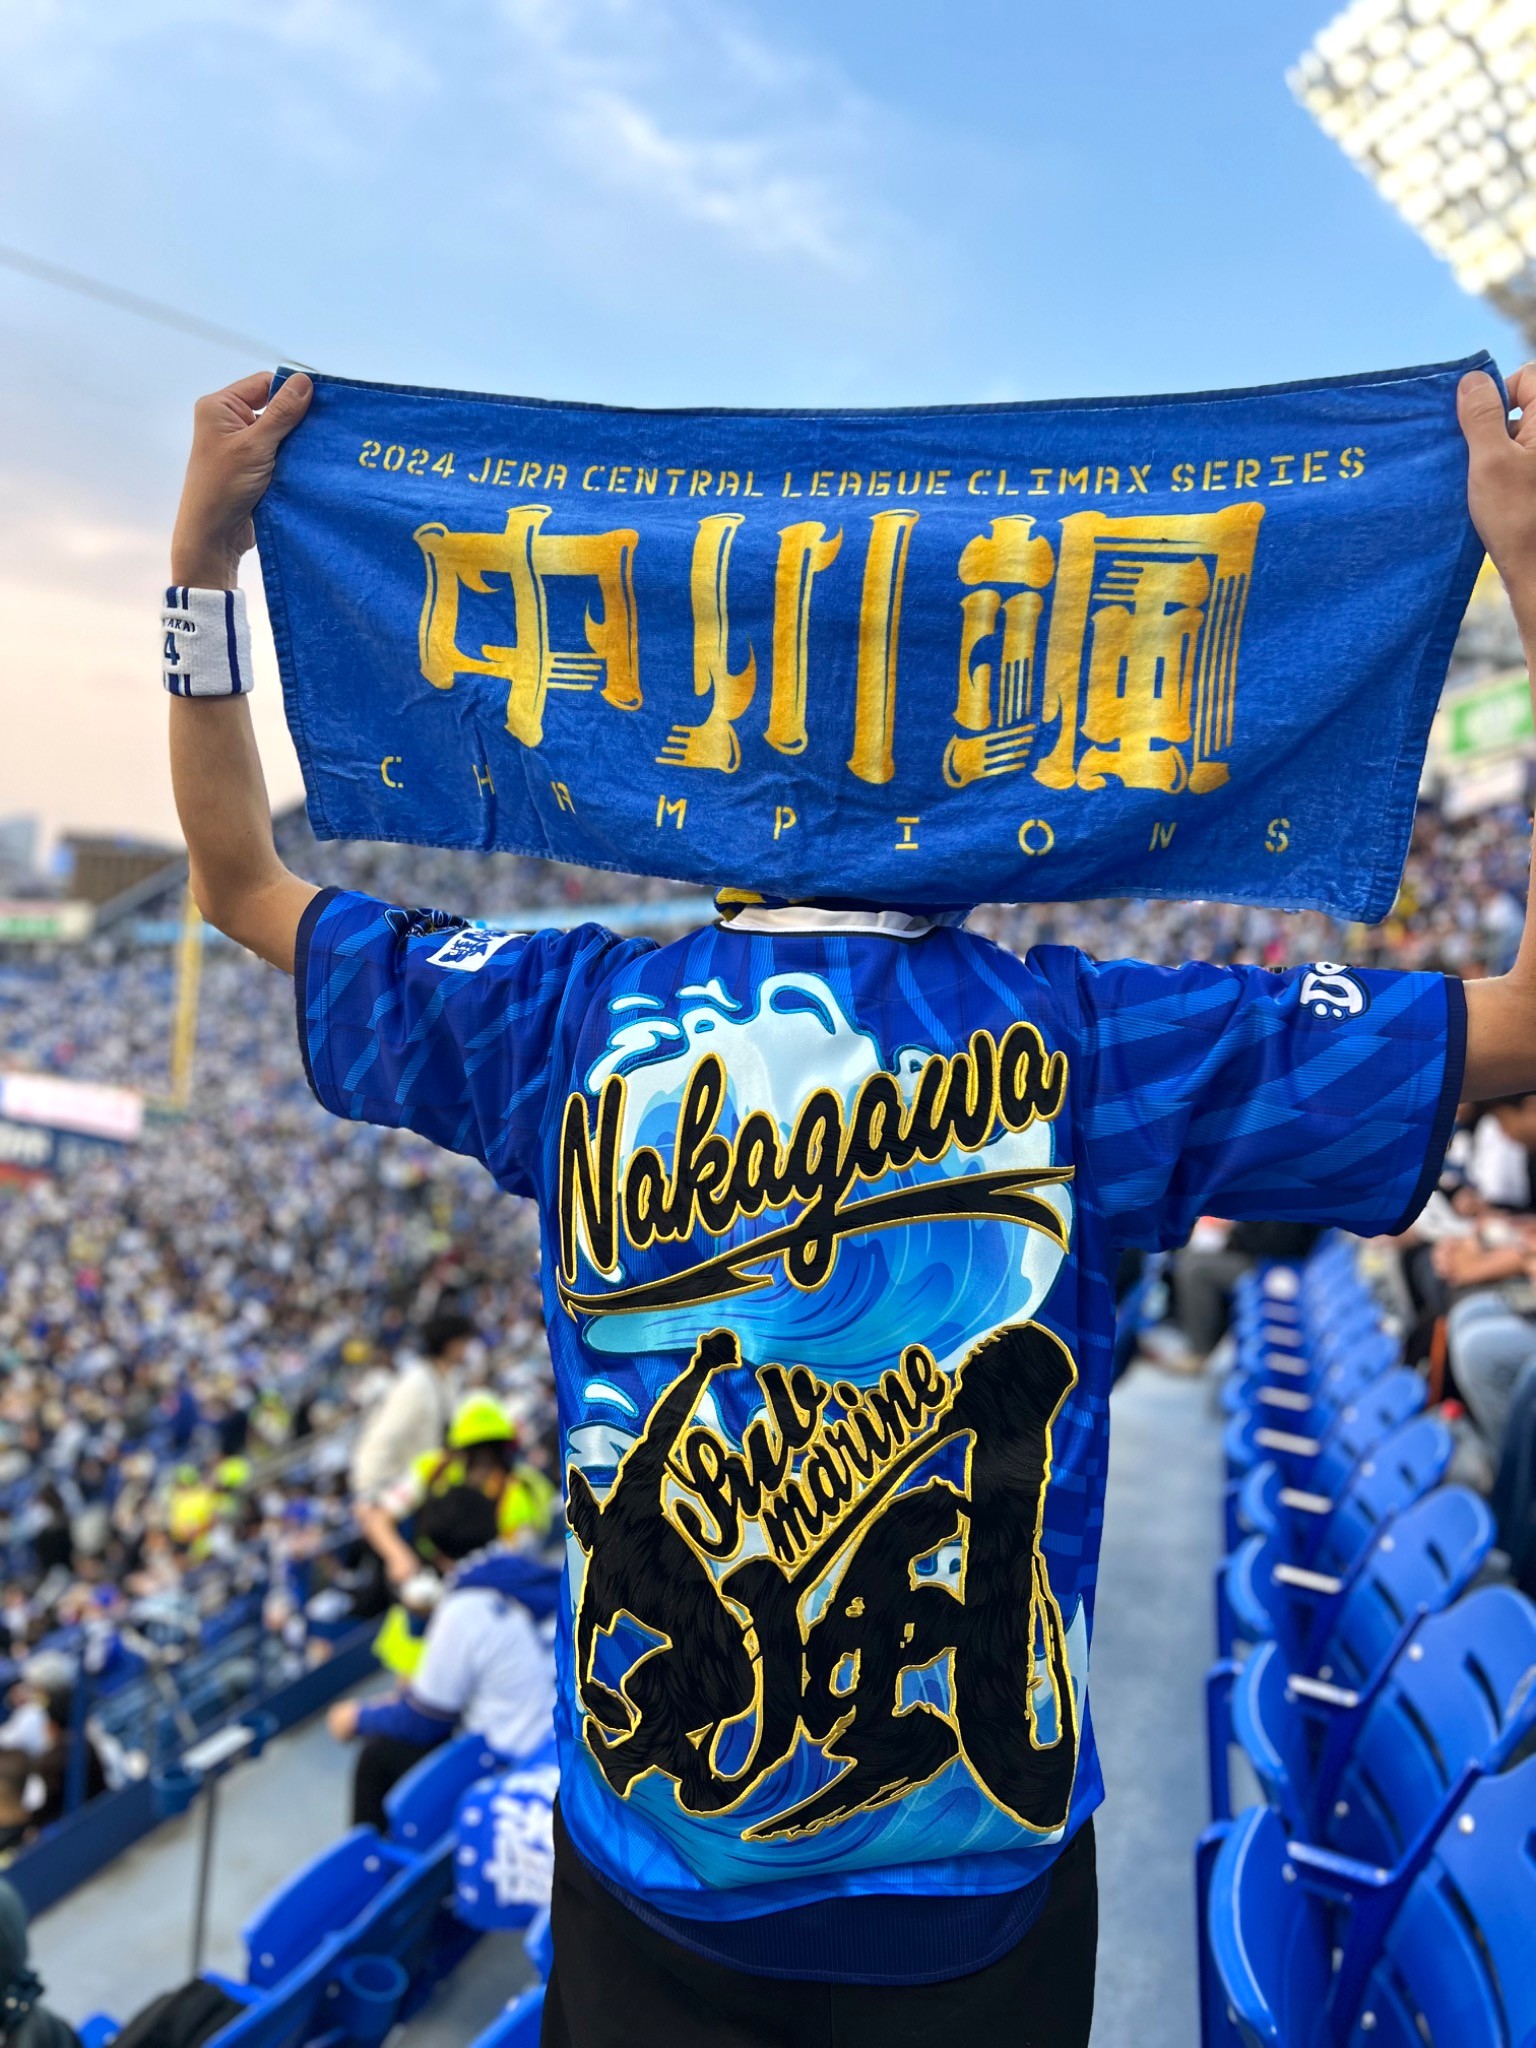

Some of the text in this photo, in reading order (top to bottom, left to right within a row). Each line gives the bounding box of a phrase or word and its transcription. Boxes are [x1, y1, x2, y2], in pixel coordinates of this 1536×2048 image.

[359, 440, 1366, 498] 2024 JERA CENTRAL LEAGUE CLIMAX SERIES
[380, 756, 1291, 857] CHAMPIONS
[558, 1020, 1070, 1293] Nakagawa
[671, 1363, 832, 1562] Sub
[758, 1343, 952, 1568] marine
